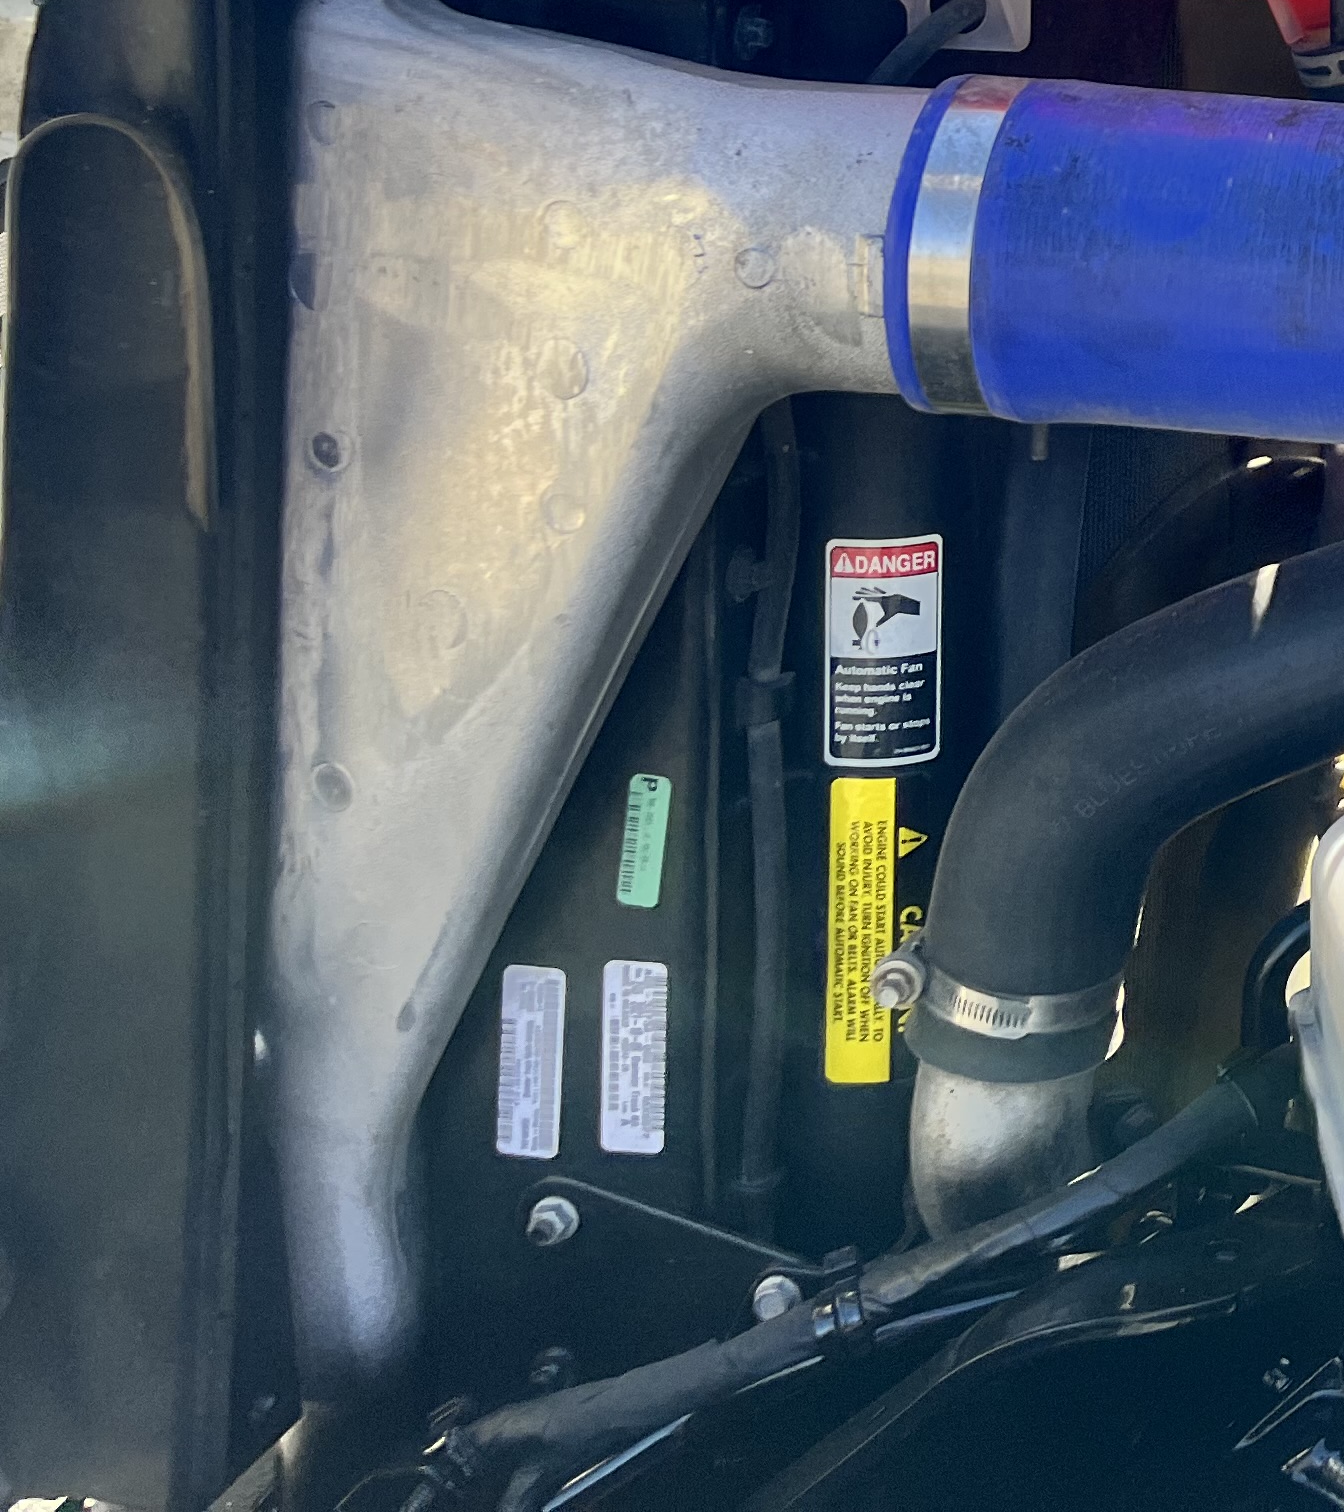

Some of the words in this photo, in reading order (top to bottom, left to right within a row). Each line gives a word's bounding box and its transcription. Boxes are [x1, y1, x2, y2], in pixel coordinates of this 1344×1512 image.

[854, 550, 936, 575] DANGER
[835, 664, 898, 675] Automatic
[900, 663, 923, 674] Fan
[835, 682, 861, 693] Keep
[863, 682, 896, 692] hands
[898, 679, 925, 690] clear
[835, 694, 862, 703] when
[863, 694, 900, 705] engine
[902, 692, 912, 702] is
[834, 721, 853, 731] Fan
[854, 723, 886, 731] starts
[887, 722, 901, 731] or
[902, 718, 931, 729] stops
[834, 732, 848, 744] by
[849, 821, 859, 876] WORKING
[862, 821, 873, 857] AVOID
[876, 820, 887, 860] ENGINE
[835, 842, 846, 881] SOUND
[848, 878, 859, 898] ON
[875, 865, 886, 901] COULD
[834, 885, 846, 925] BEFORE
[848, 901, 858, 924] FAN
[861, 902, 871, 931] TURN
[847, 925, 858, 942] OR
[875, 905, 886, 935] START
[833, 927, 845, 991] AUTOMATIC
[860, 934, 871, 983] IGNITION
[846, 979, 856, 1016] ALARM
[860, 986, 870, 1008] OFF
[845, 1019, 855, 1041] WILL
[859, 1010, 869, 1042] WHEN
[872, 1028, 883, 1042] TO
